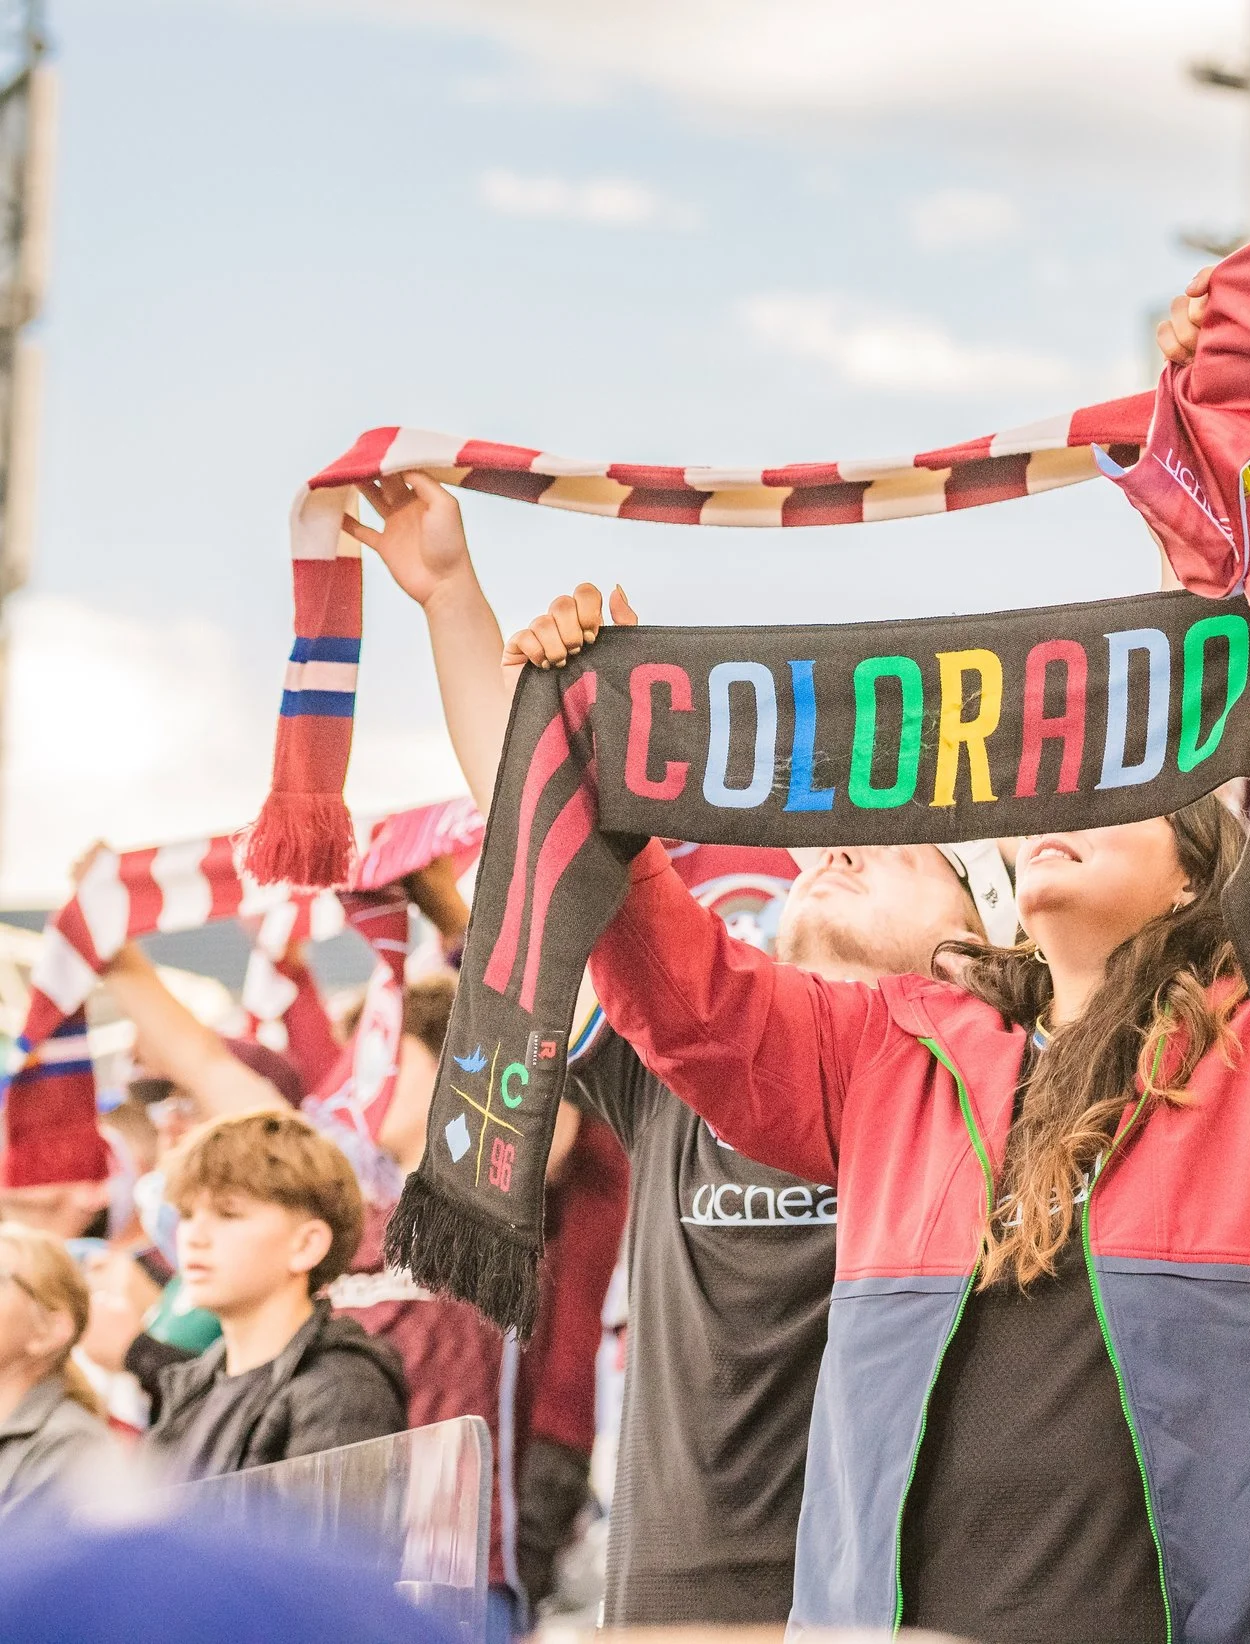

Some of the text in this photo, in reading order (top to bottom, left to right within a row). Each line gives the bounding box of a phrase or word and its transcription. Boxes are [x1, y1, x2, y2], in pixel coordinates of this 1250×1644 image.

[625, 614, 1249, 812] COLORADO
[538, 1041, 556, 1060] R
[501, 1062, 529, 1109] C
[489, 1137, 515, 1193] 96
